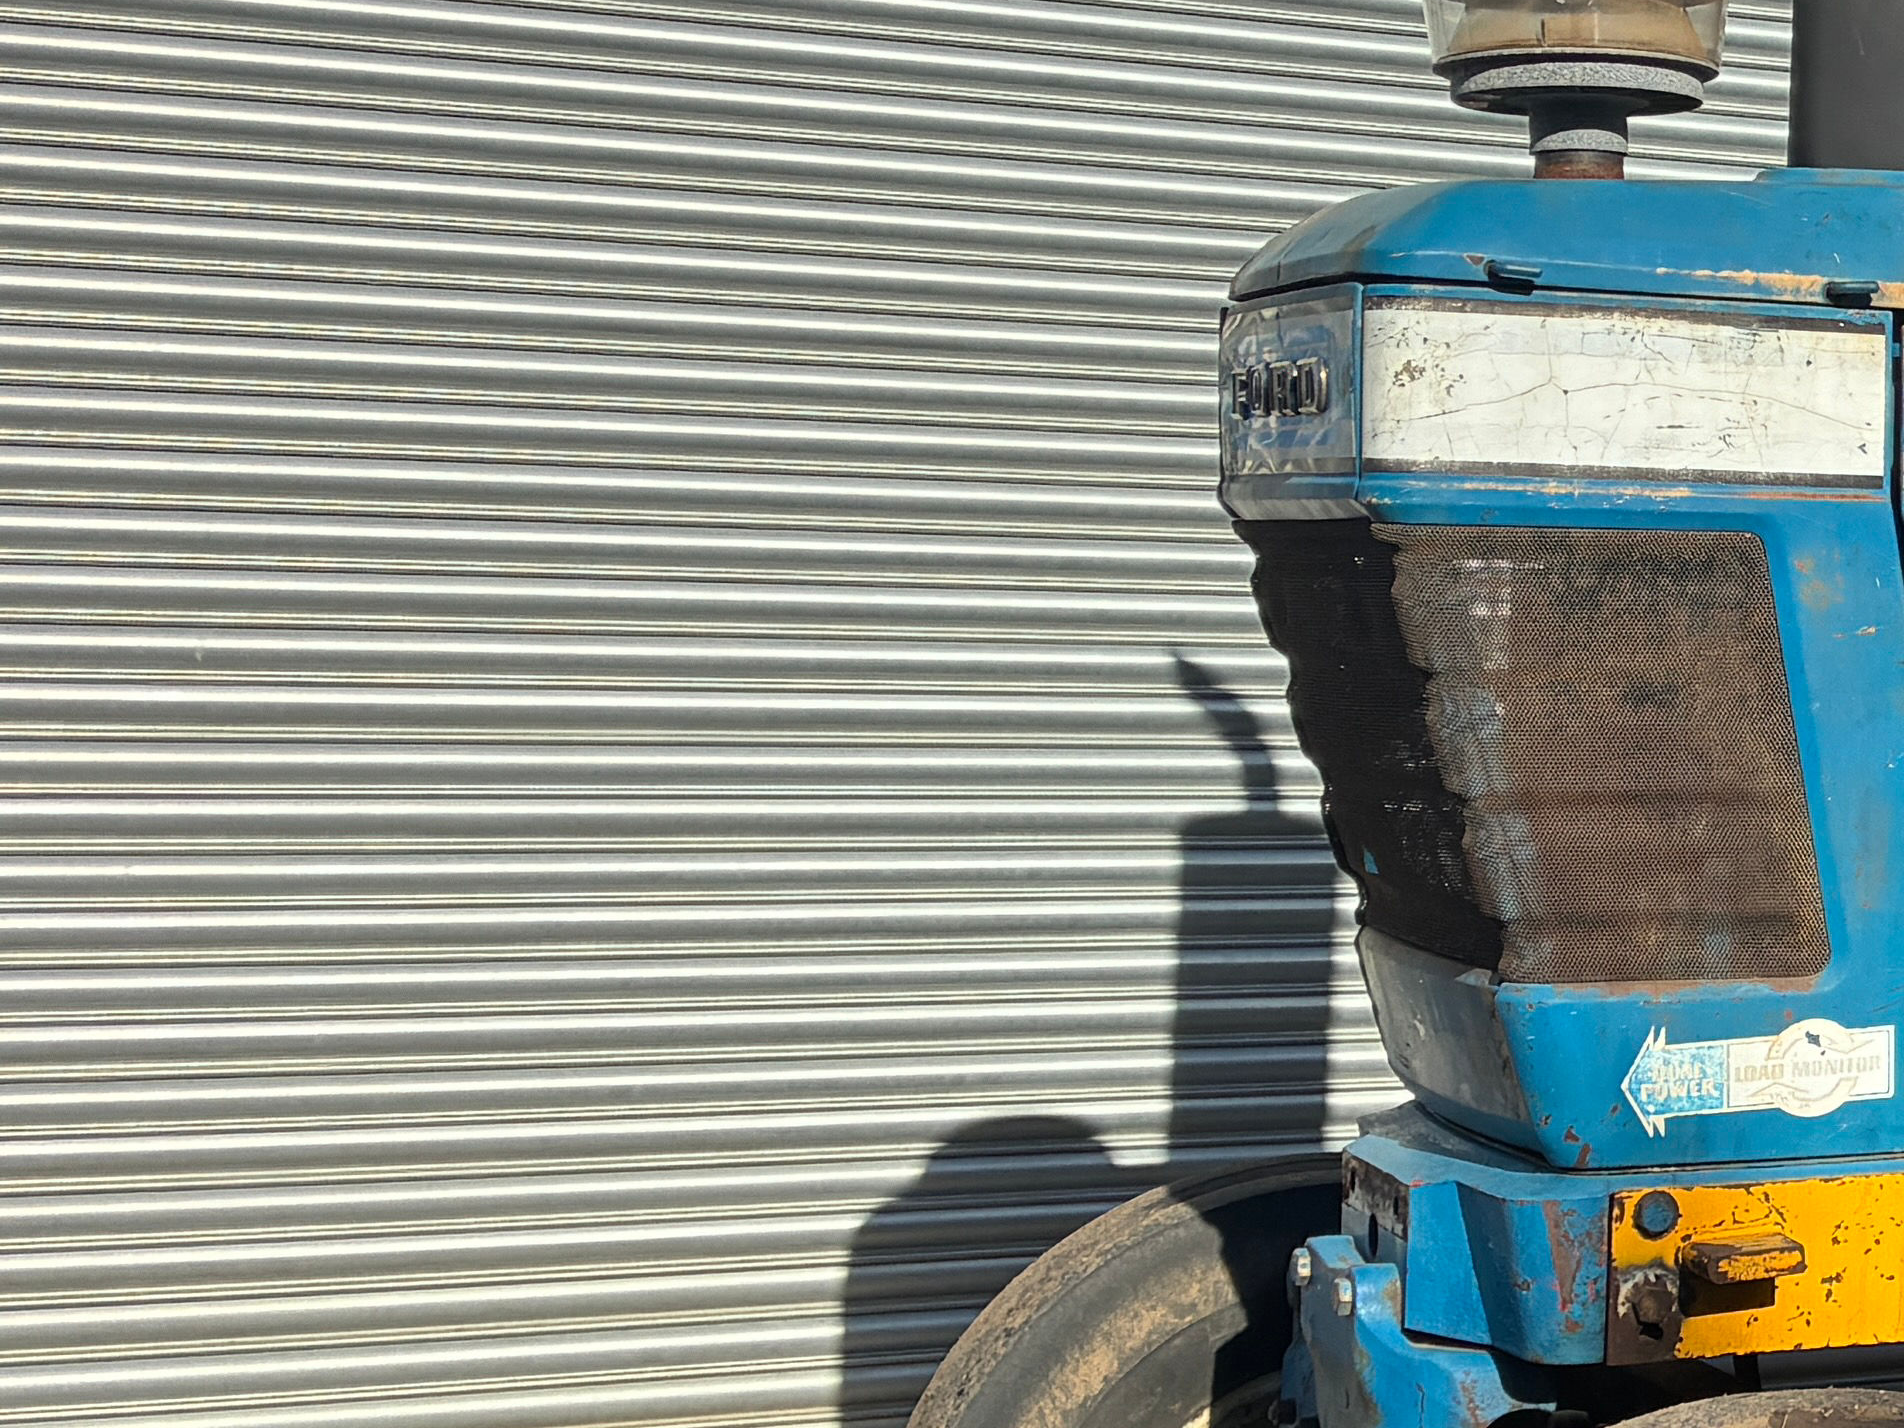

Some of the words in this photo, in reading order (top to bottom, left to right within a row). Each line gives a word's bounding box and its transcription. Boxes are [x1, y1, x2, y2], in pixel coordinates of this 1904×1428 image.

[1231, 356, 1328, 420] FORD
[1734, 1063, 1785, 1083] LOAD
[1791, 1055, 1881, 1078] MONITOR
[1640, 1077, 1720, 1103] POWER
